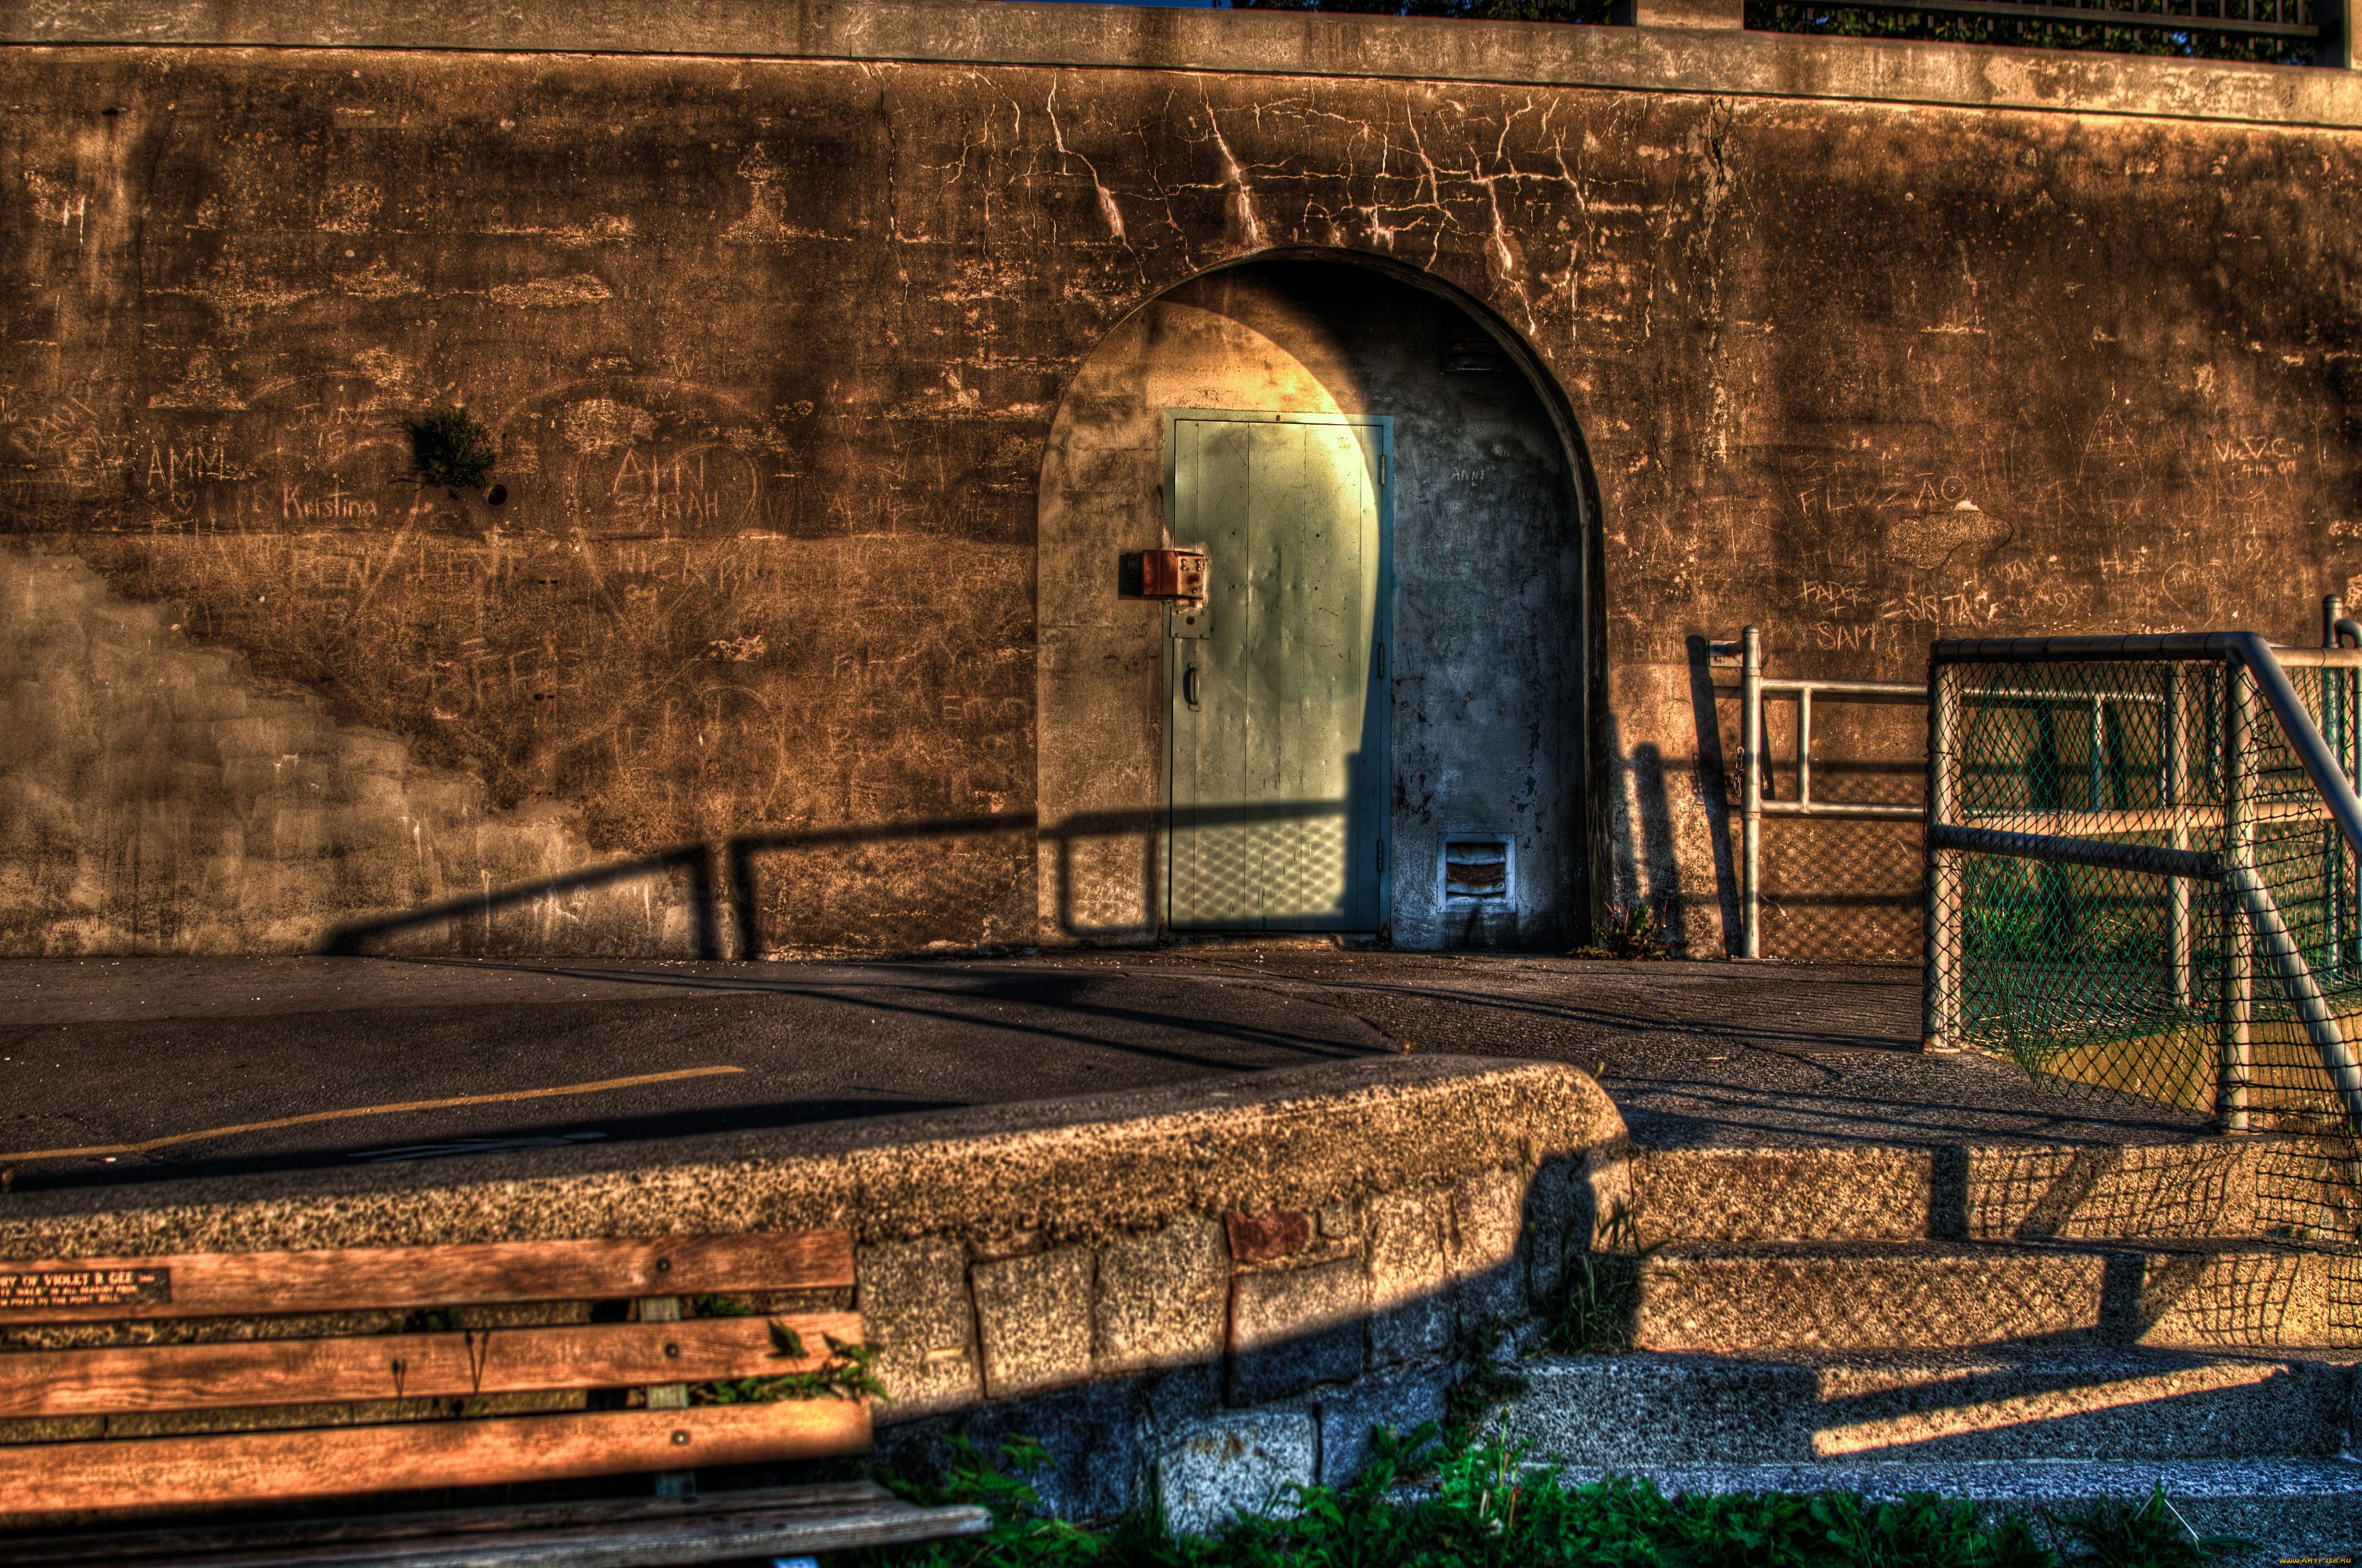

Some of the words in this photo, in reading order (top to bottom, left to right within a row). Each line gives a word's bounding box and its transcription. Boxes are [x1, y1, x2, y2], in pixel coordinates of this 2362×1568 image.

[281, 475, 379, 520] Kristina
[21, 1274, 39, 1287] OF
[42, 1273, 89, 1287] VIOLET
